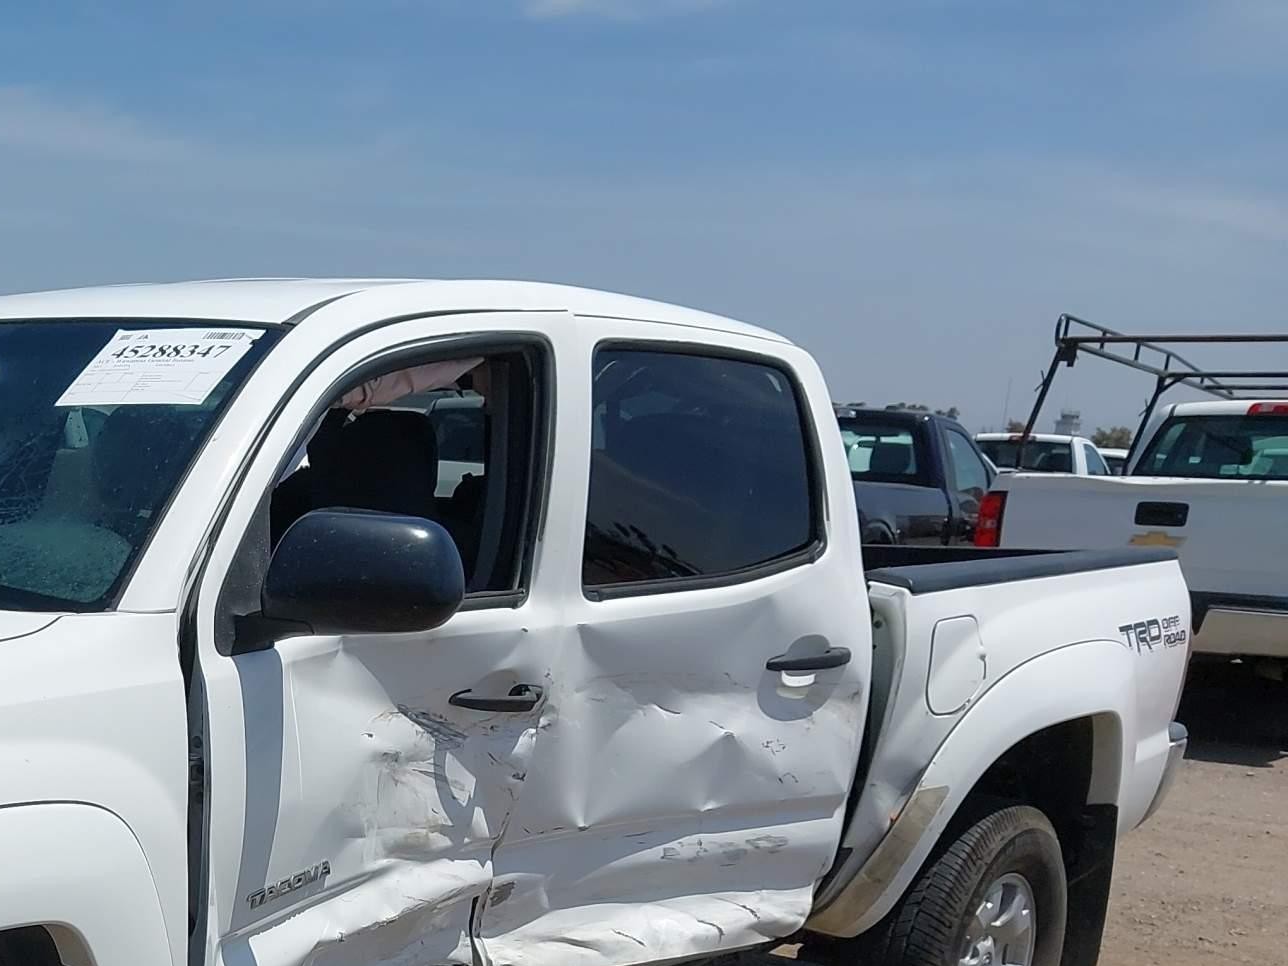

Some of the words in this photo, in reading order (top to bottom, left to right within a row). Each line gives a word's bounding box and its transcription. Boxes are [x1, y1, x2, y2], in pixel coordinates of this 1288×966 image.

[111, 344, 232, 359] 45288347
[1118, 618, 1162, 655] TRD
[1163, 630, 1186, 647] ROAD
[247, 860, 331, 909] TACOMA
